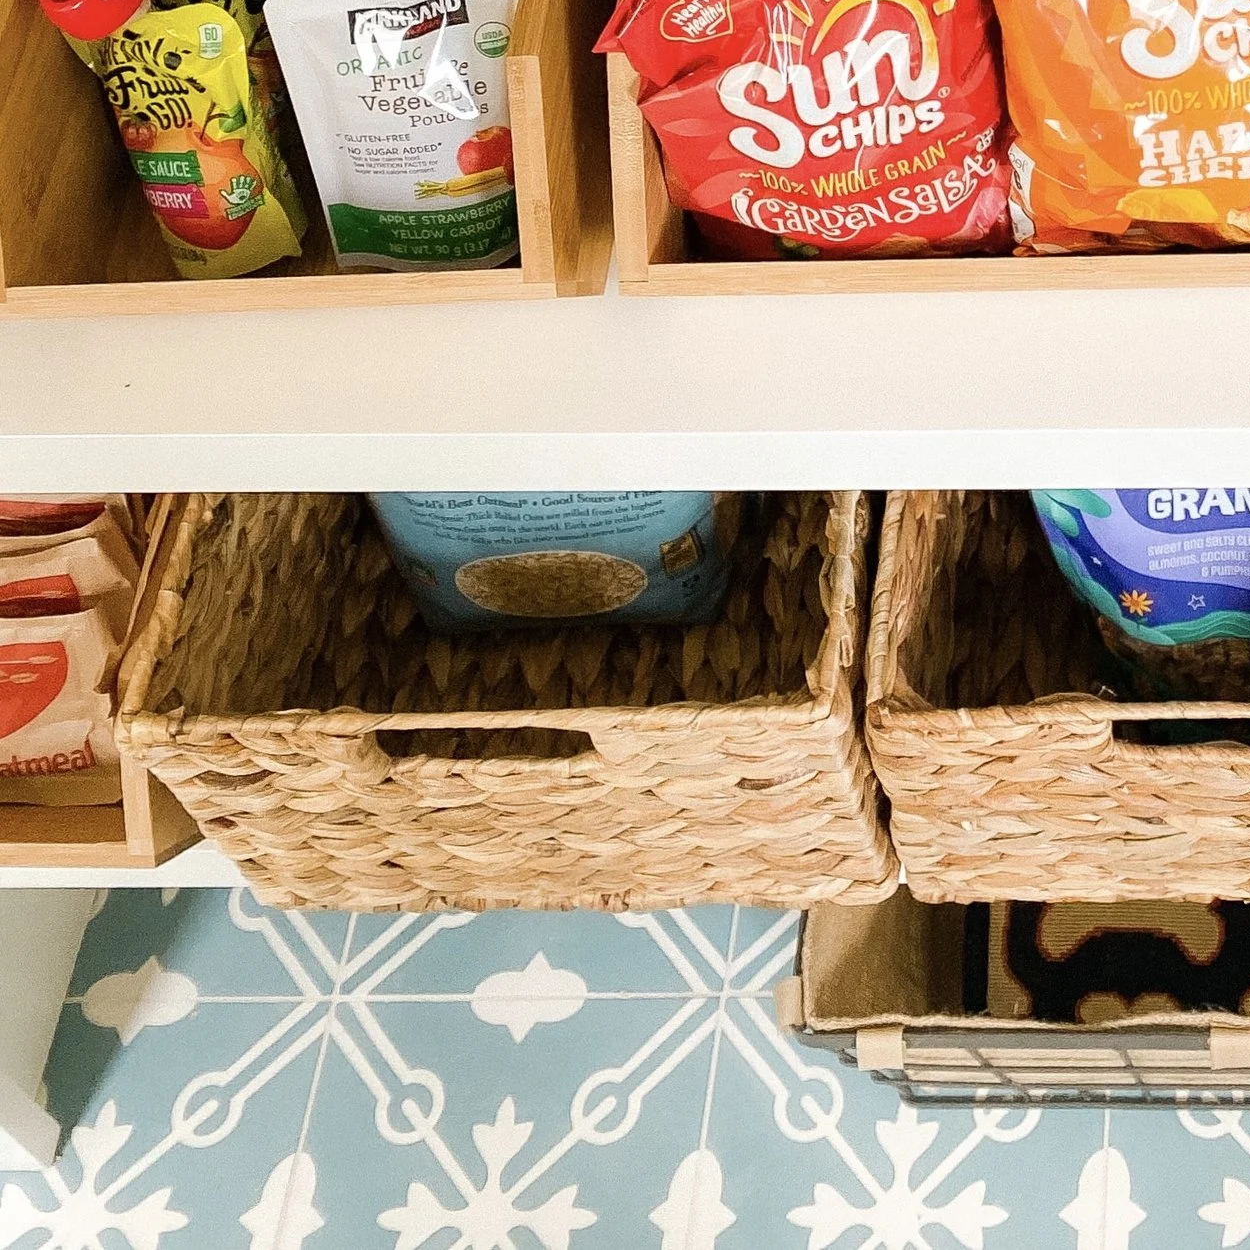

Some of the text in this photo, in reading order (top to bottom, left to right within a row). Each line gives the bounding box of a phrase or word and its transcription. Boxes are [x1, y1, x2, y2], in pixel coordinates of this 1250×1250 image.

[682, 2, 726, 38] Healthy
[481, 30, 503, 41] USDA
[336, 46, 423, 76] ORAIC
[370, 69, 426, 93] Frui
[717, 30, 940, 169] Sun
[1145, 88, 1200, 116] 100%
[344, 133, 411, 143] GLUTEN-FREE
[808, 100, 945, 159] CHIPS
[347, 147, 361, 155] NO
[367, 146, 399, 156] SUGAR
[150, 160, 192, 178] SAUCE
[758, 139, 947, 199] 100% WHOLE GRAIN
[145, 191, 193, 210] BERRY
[379, 196, 510, 226] APPLE STRAWBERRY
[391, 228, 444, 240] YELLOW
[450, 216, 502, 238] CARROT
[542, 494, 573, 506] Good
[577, 493, 615, 503] Source
